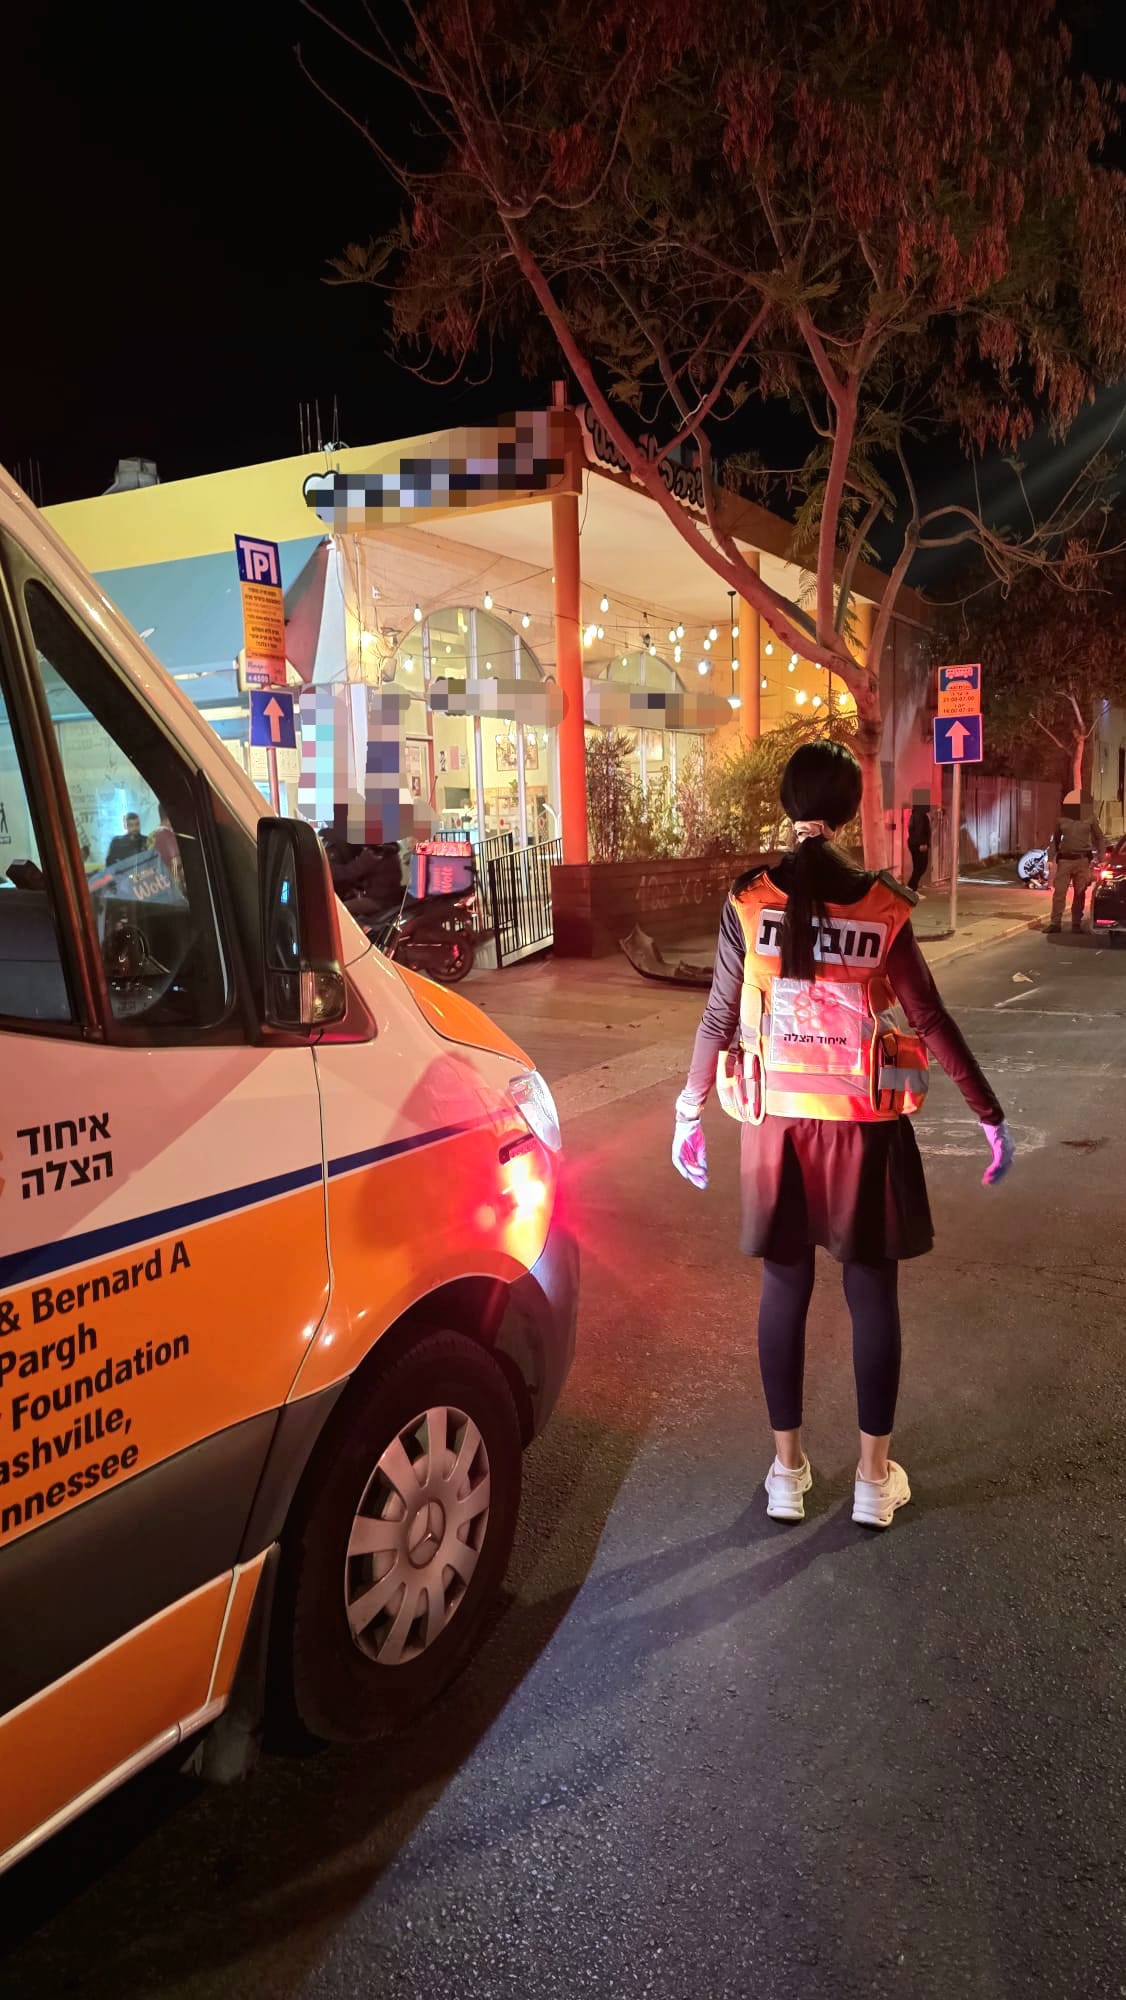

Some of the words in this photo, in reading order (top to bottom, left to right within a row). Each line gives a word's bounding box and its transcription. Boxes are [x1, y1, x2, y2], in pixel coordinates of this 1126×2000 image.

[133, 875, 170, 900] Wolt
[759, 919, 881, 958] חובת
[784, 1033, 814, 1044] הצלה
[816, 1035, 847, 1045] איחוד
[17, 1112, 112, 1156] איחוד
[21, 1151, 114, 1200] הצלה
[0, 1299, 21, 1337] &
[31, 1248, 163, 1325] Bernard
[169, 1240, 192, 1274] A
[0, 1322, 98, 1388] Pargh
[11, 1333, 190, 1432] Foundation
